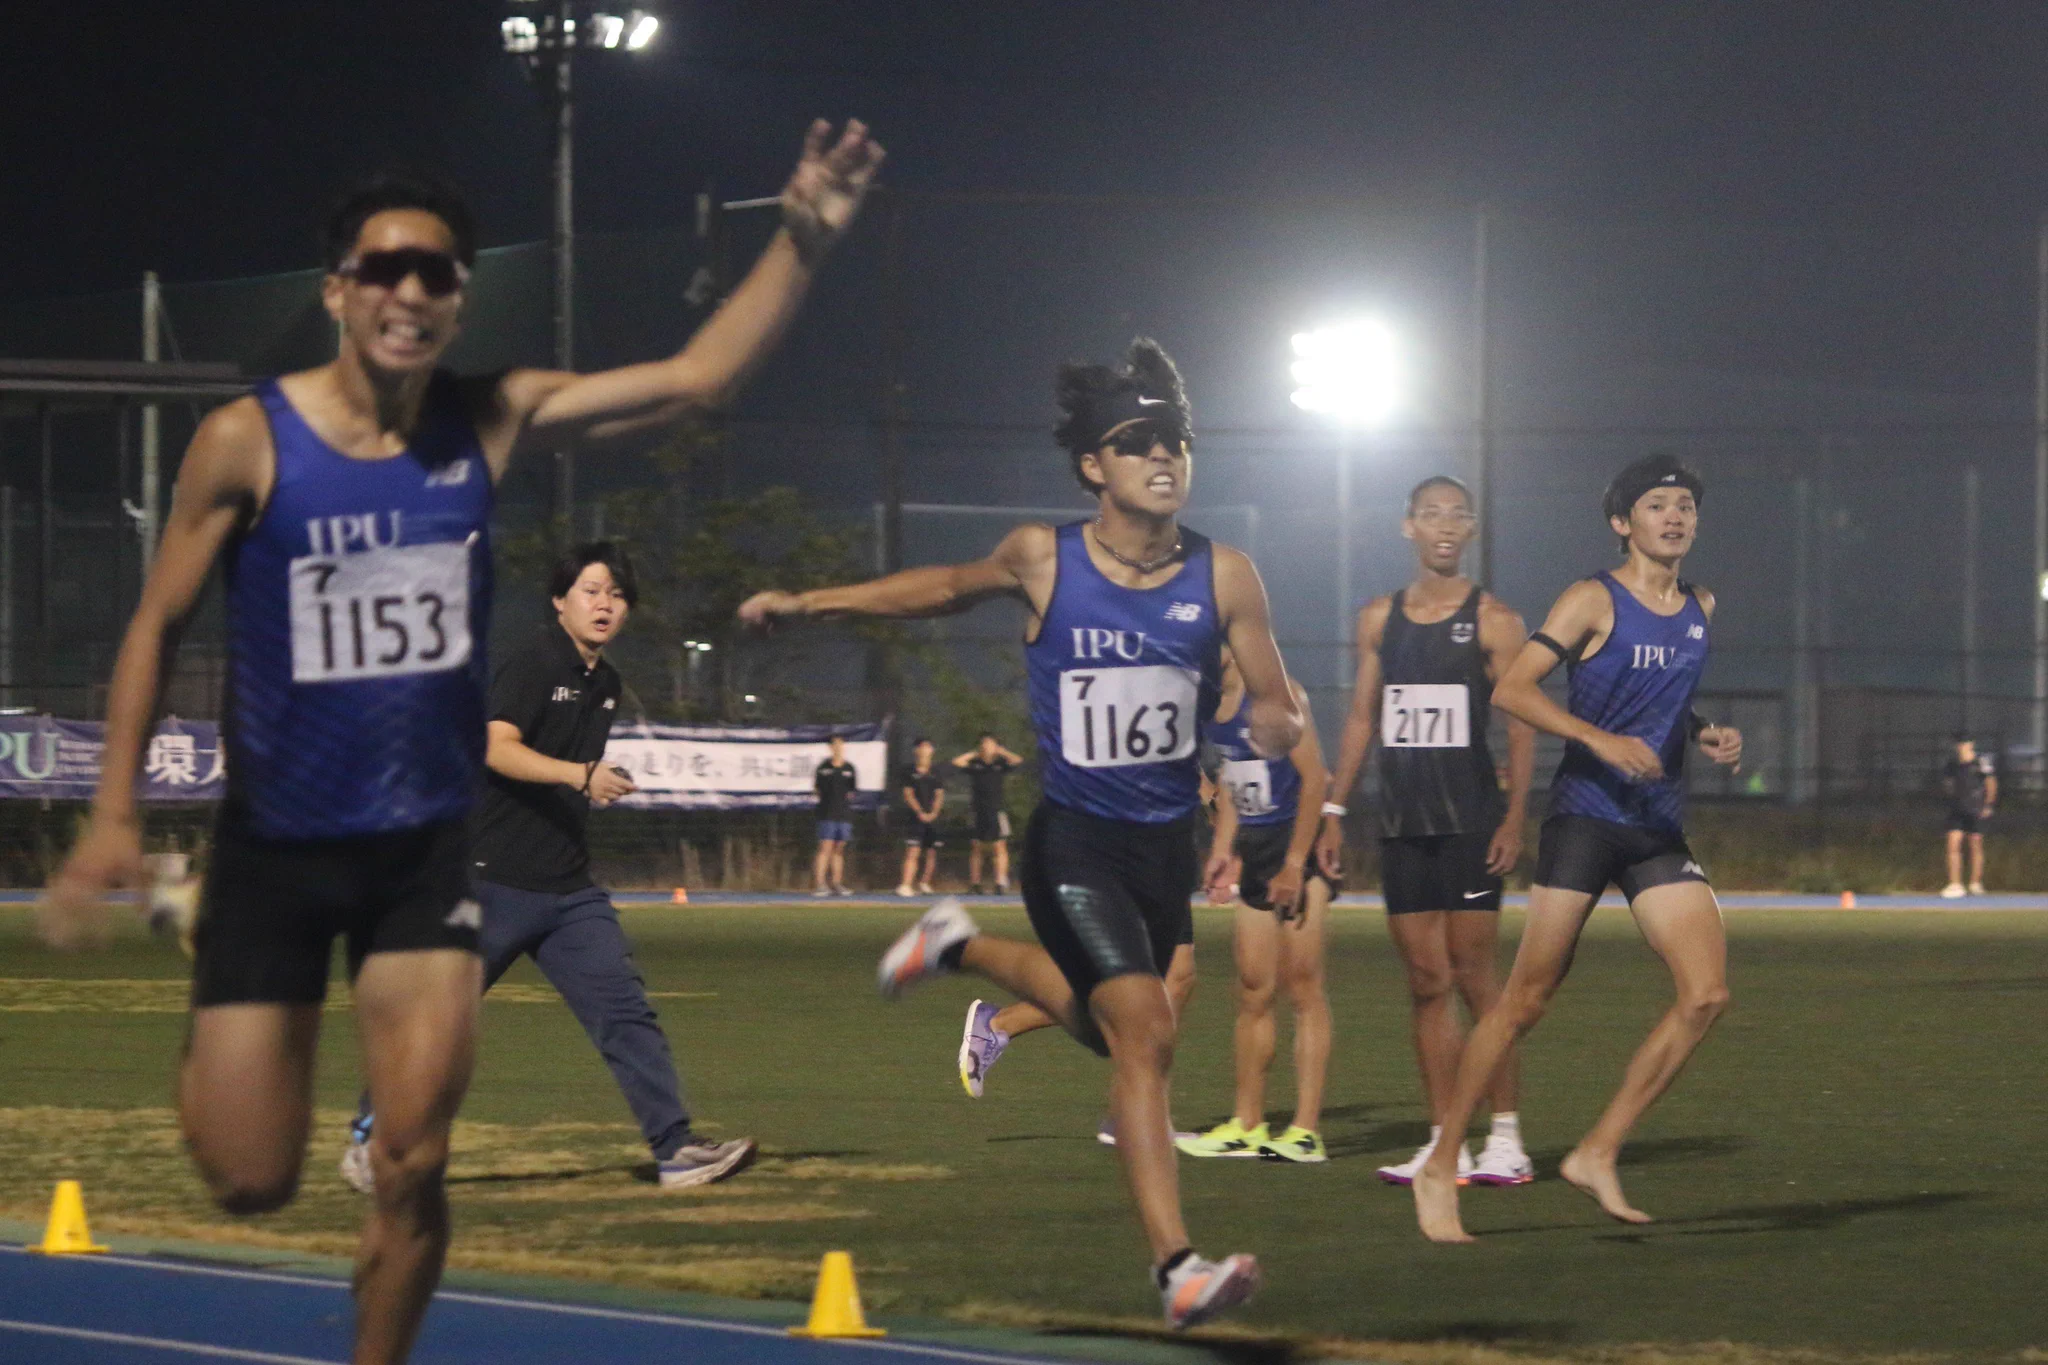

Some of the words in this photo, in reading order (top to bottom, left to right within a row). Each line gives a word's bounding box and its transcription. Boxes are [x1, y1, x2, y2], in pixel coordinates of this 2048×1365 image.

[307, 509, 401, 555] IPU
[301, 562, 337, 594] 7
[319, 592, 447, 671] 1153
[1071, 627, 1147, 660] IPU
[1632, 644, 1676, 670] IPU
[1072, 676, 1096, 700] 7
[1391, 688, 1404, 705] 7
[1083, 701, 1179, 760] 1163
[1394, 707, 1454, 743] 2171
